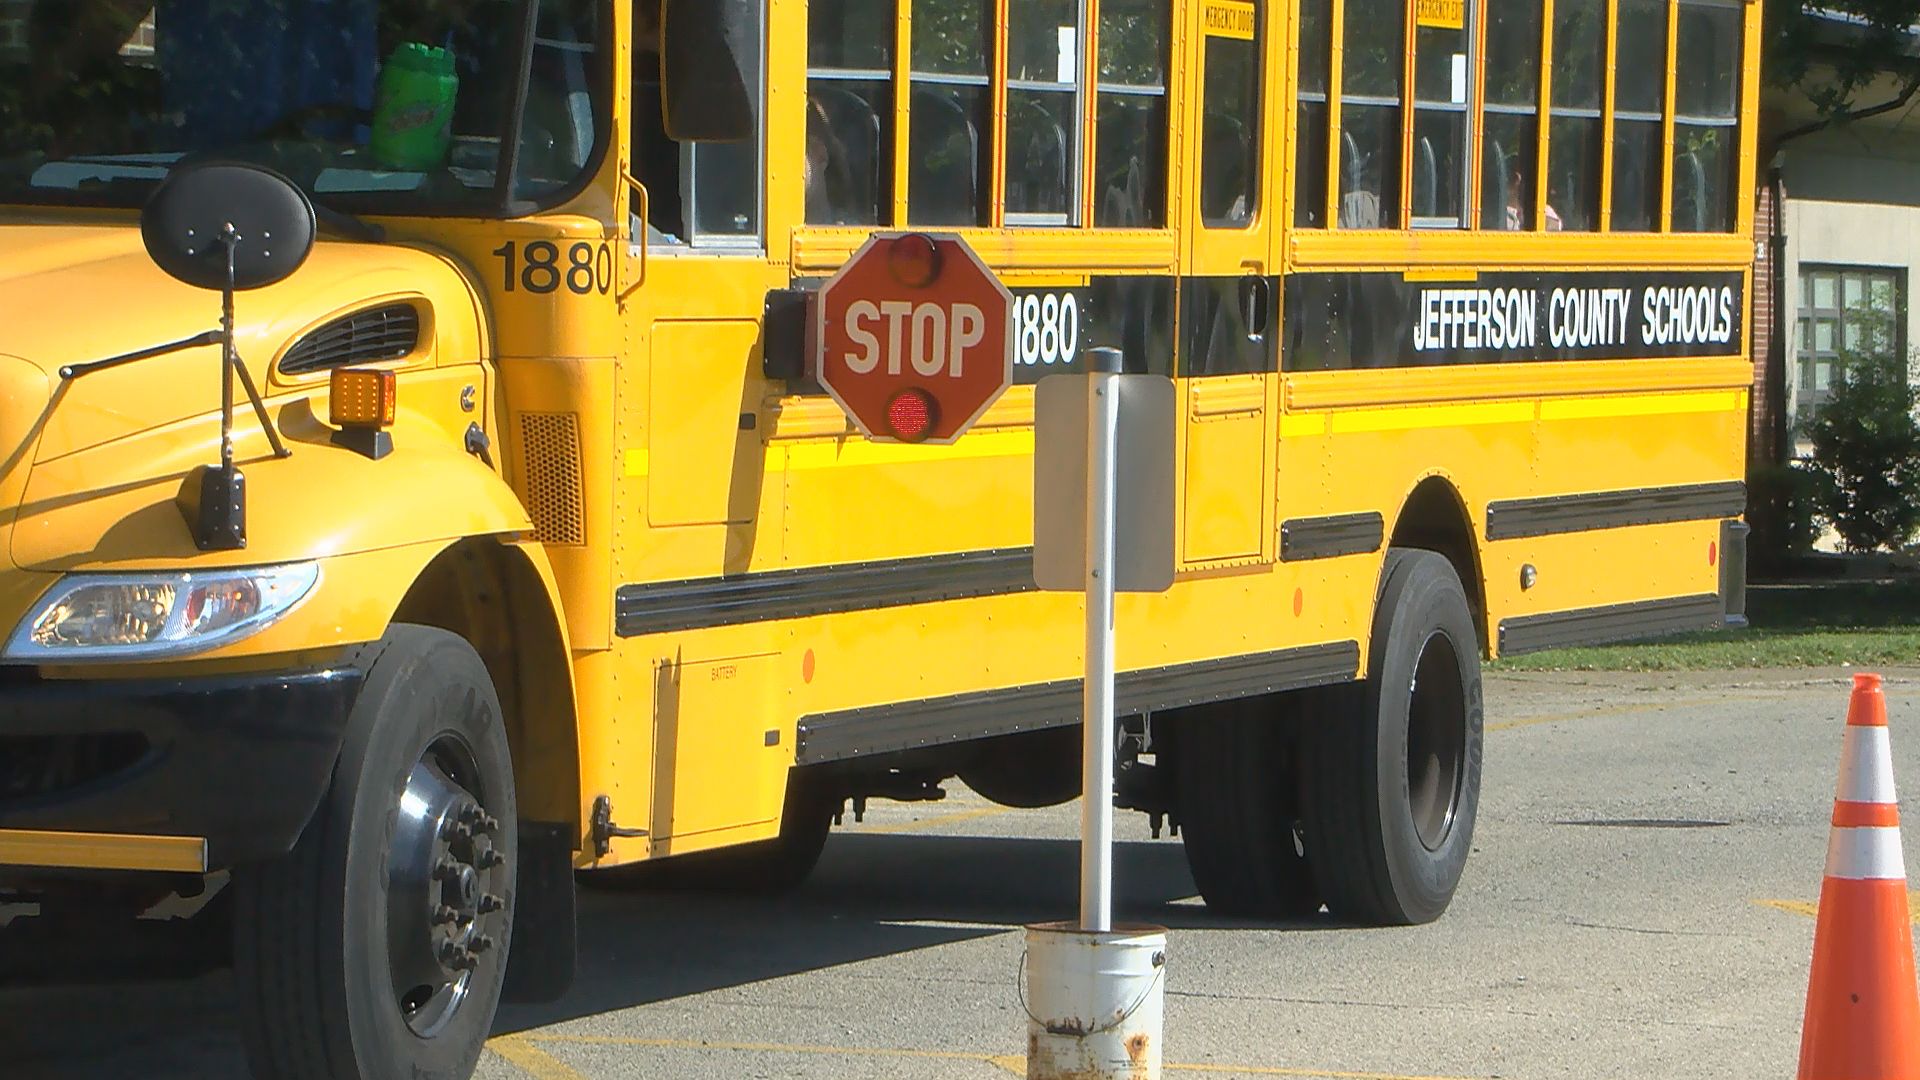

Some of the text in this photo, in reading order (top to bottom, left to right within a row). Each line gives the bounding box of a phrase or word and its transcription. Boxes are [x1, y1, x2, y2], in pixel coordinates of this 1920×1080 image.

[1206, 5, 1237, 30] MERGENCY
[493, 241, 611, 295] 1880
[844, 299, 985, 378] STOP
[1013, 292, 1078, 366] 1880
[1413, 285, 1731, 351] JEFFERSON COUNTY SCHOOLS
[711, 665, 737, 681] BATTERY
